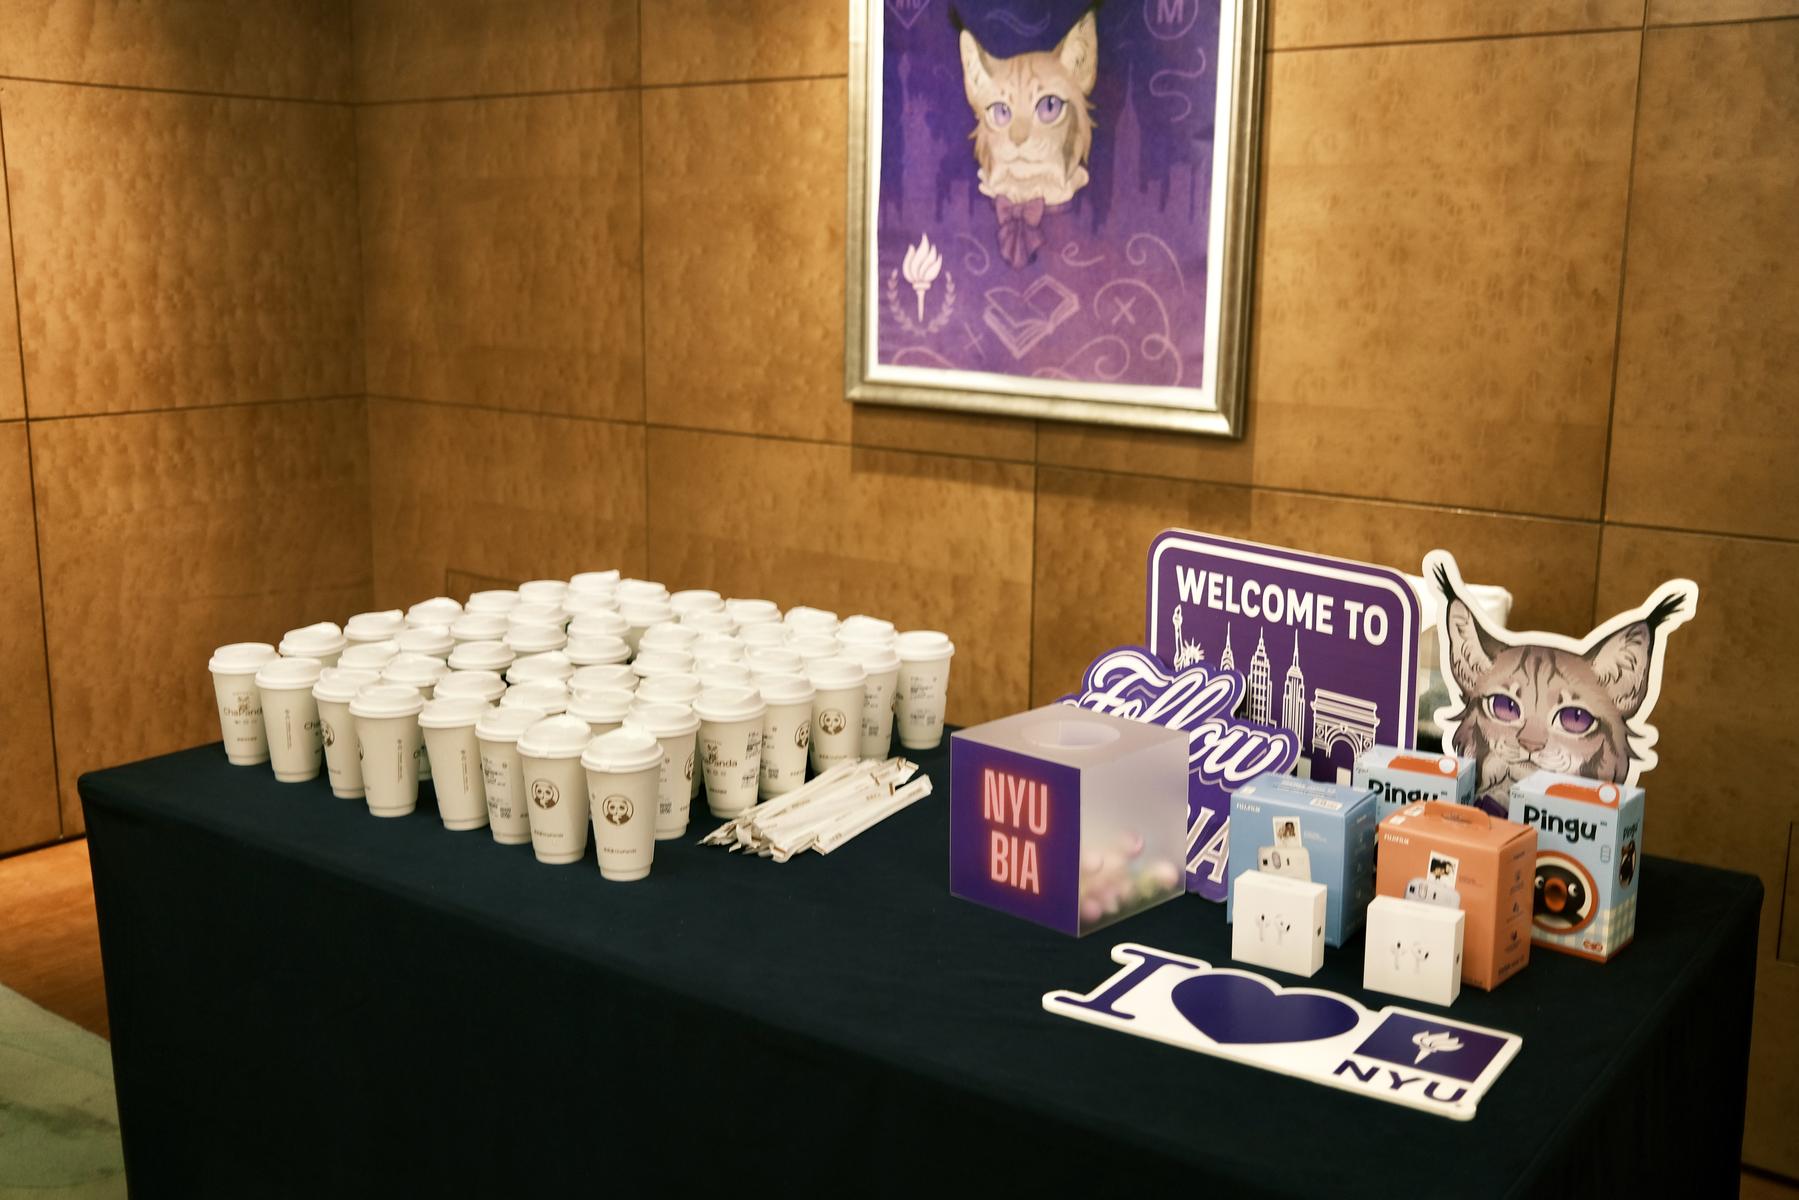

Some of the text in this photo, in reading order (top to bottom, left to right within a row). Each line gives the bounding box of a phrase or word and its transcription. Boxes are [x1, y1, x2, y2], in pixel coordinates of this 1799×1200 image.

[1176, 564, 1389, 646] WELCOME TO
[984, 768, 1048, 835] NYU
[1523, 804, 1597, 844] Pingu
[991, 830, 1040, 894] BIA
[1186, 804, 1230, 884] IA
[1054, 947, 1469, 1103] I NYU
